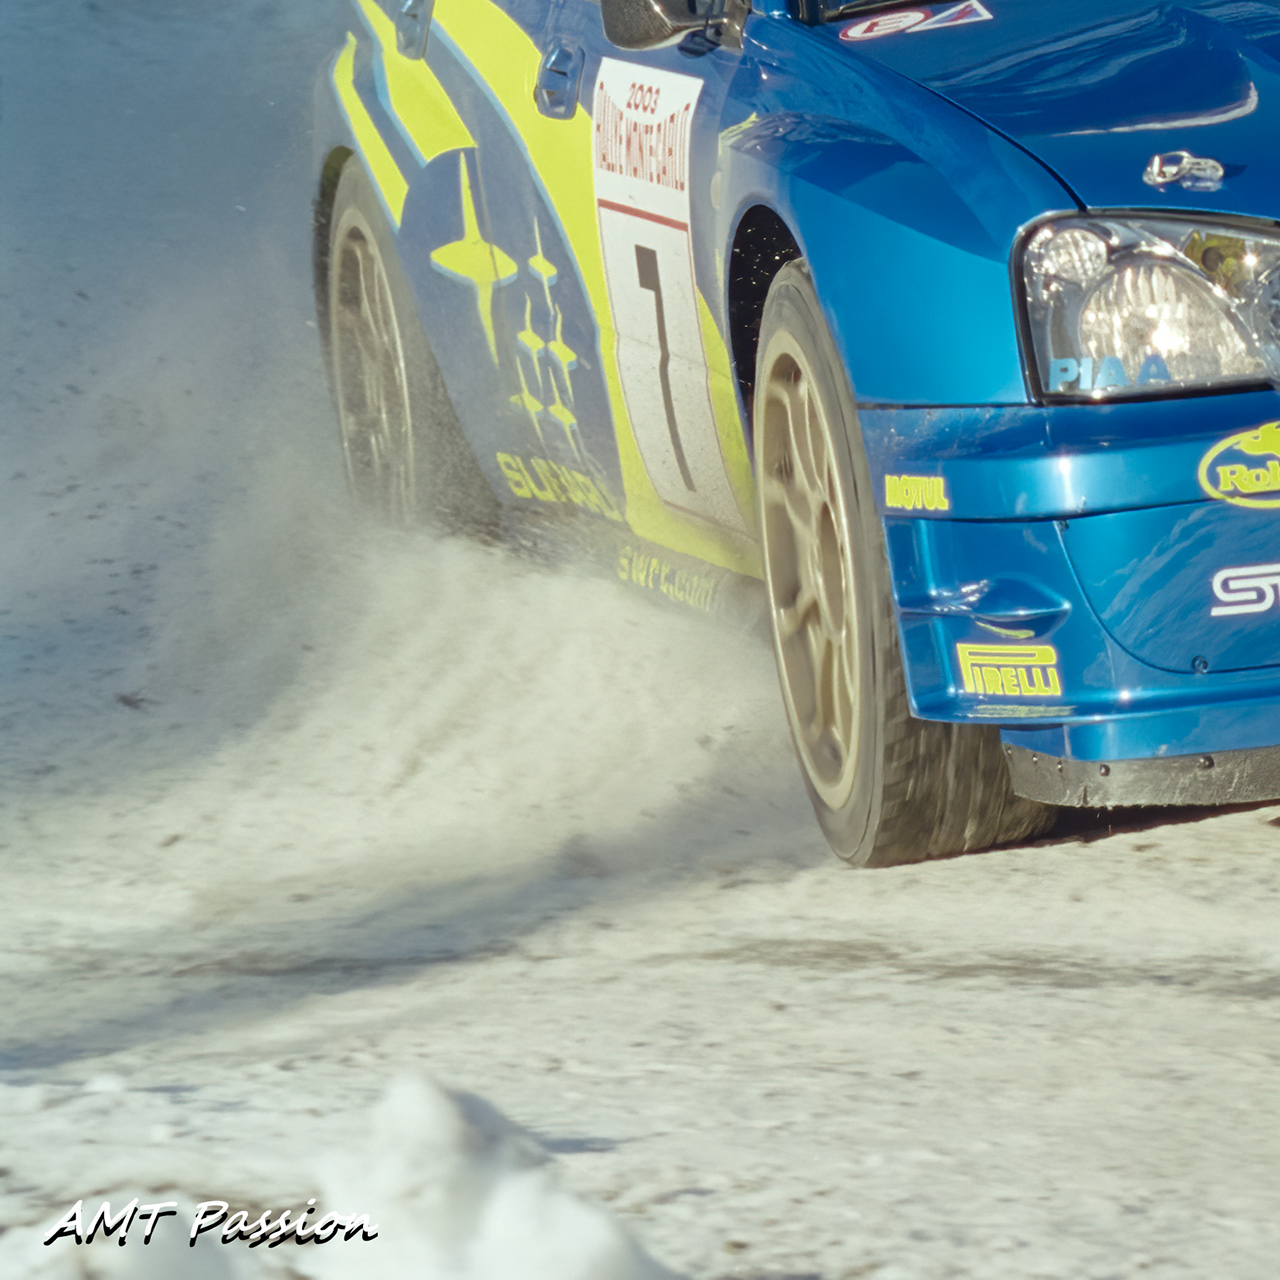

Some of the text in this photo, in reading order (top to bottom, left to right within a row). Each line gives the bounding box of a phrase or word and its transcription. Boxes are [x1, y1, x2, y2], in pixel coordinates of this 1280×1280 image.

[626, 81, 660, 114] 2003
[634, 243, 697, 493] 7
[1050, 354, 1171, 392] PIAA
[885, 475, 949, 510] MOTUL
[957, 643, 1062, 697] PIRELLI
